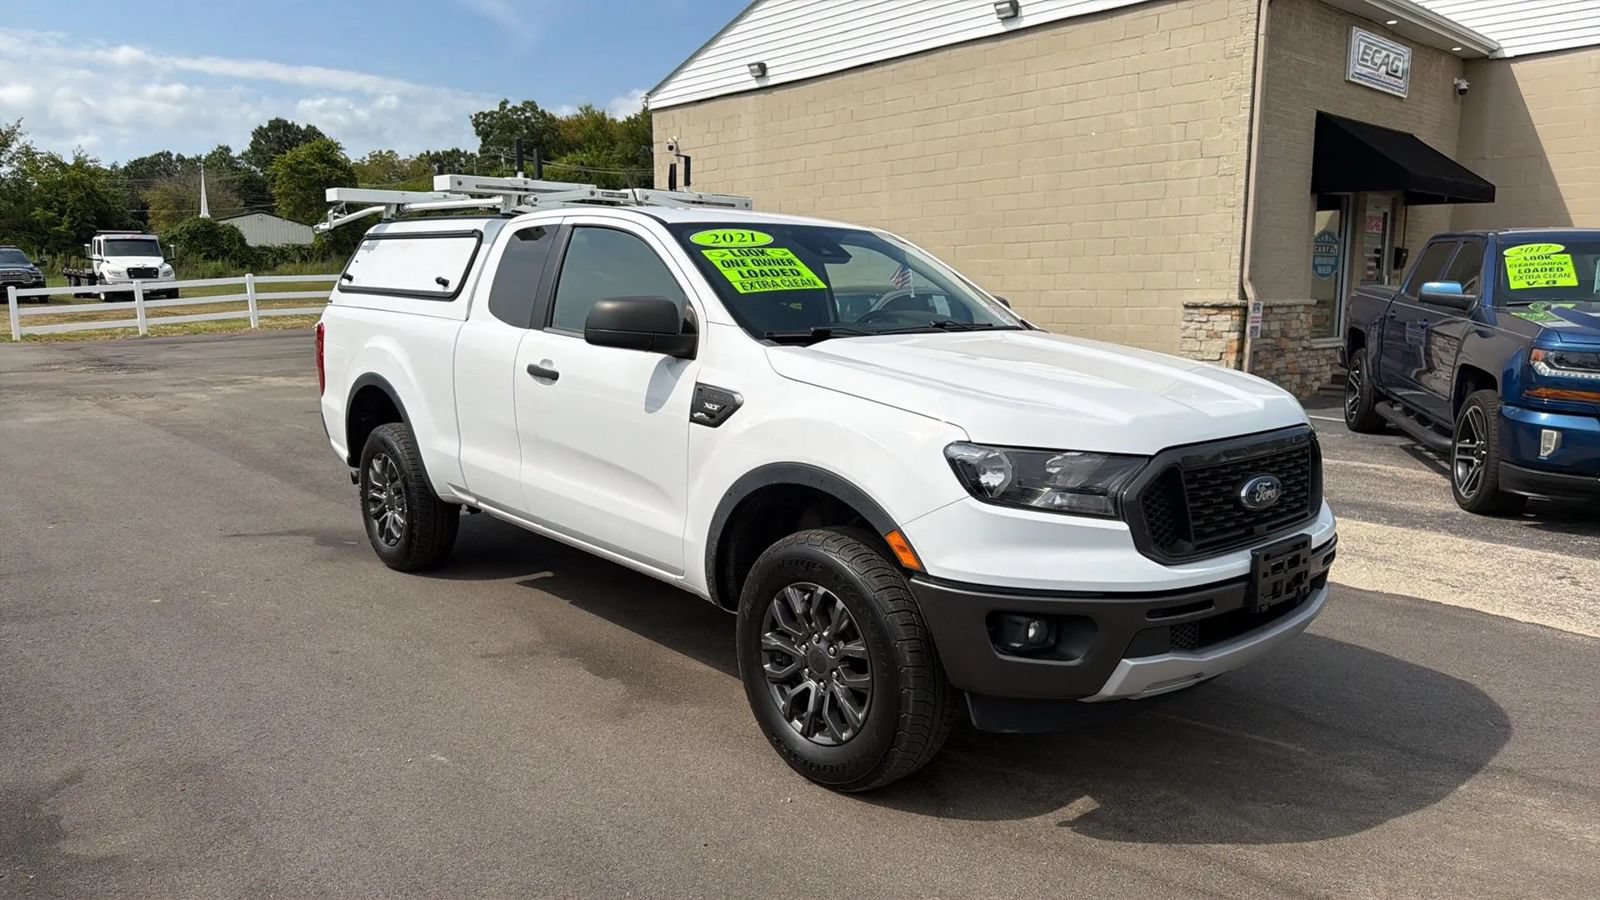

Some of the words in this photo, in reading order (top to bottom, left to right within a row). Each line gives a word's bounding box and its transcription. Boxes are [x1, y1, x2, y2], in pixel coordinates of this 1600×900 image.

[1359, 44, 1402, 74] ECAG
[709, 232, 757, 244] 2021
[728, 249, 769, 257] LOOK
[1515, 245, 1552, 255] 2017
[721, 260, 749, 268] ONE
[752, 259, 796, 267] OWNER
[738, 268, 802, 279] LOADED
[740, 280, 779, 291] EXTRA
[781, 279, 818, 288] CLEAN
[1255, 481, 1276, 502] Ford
